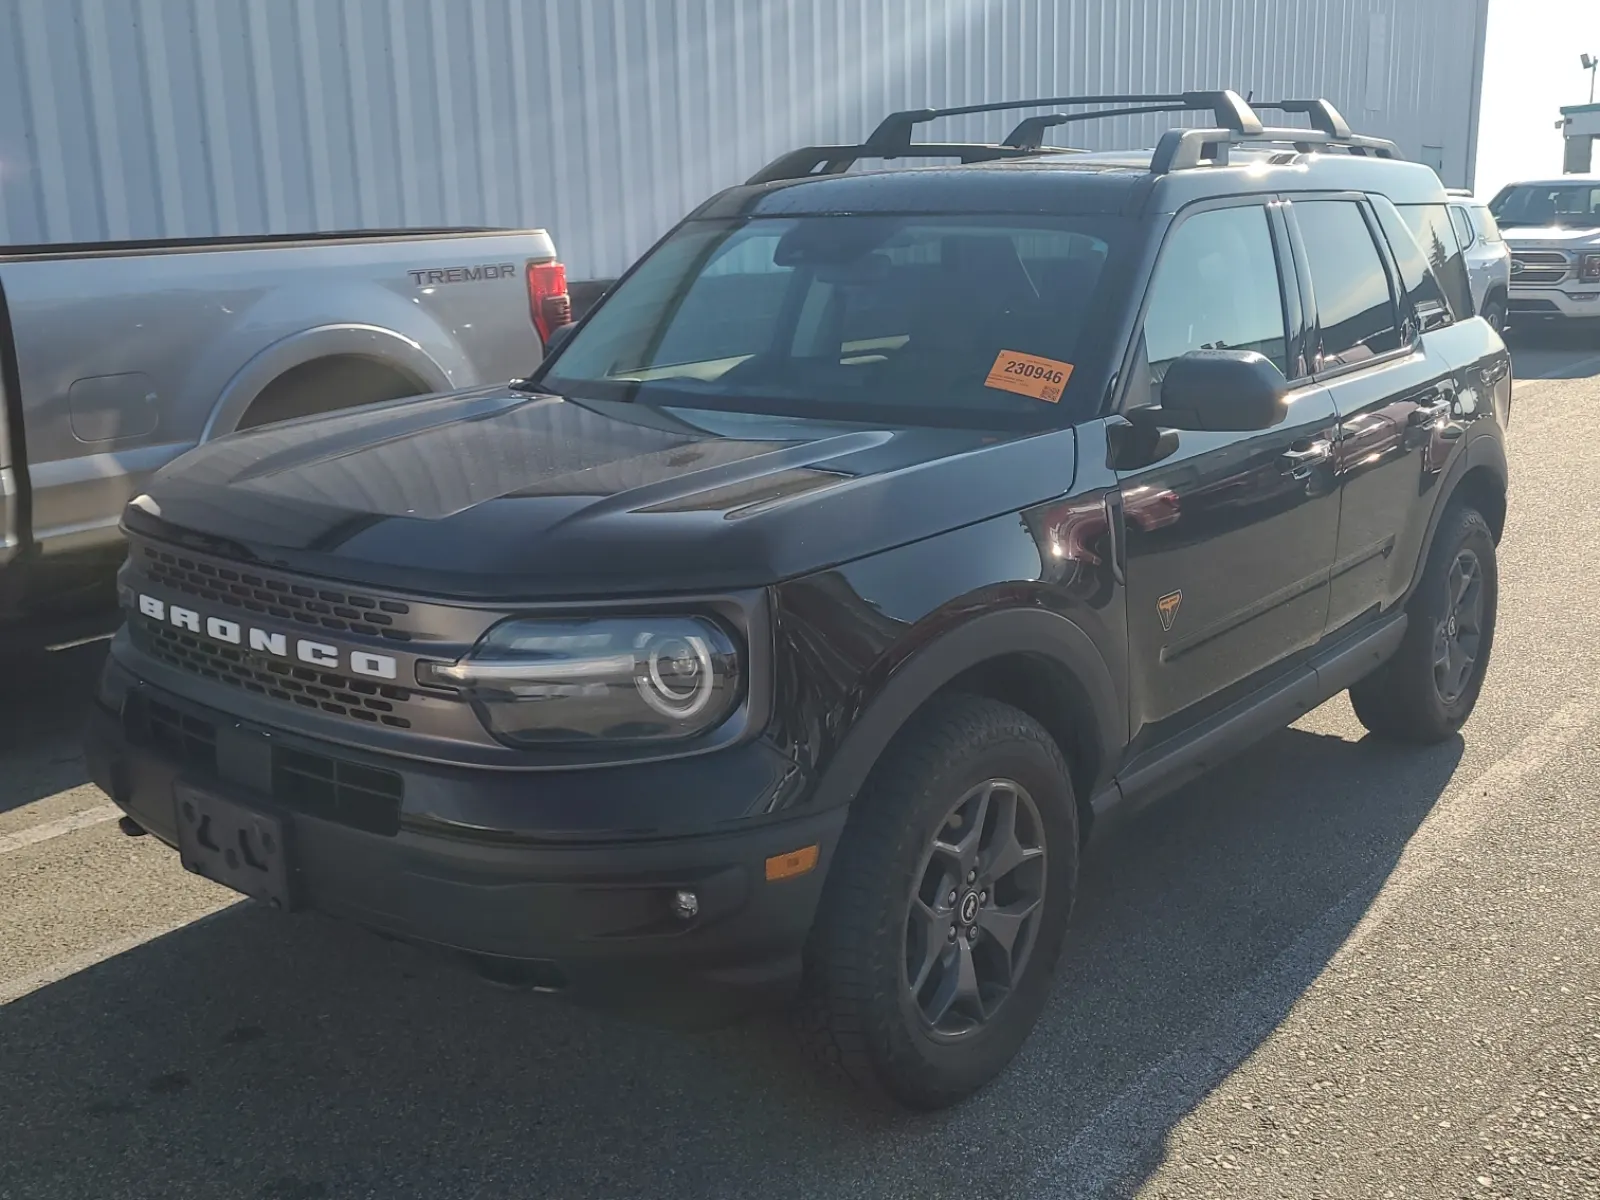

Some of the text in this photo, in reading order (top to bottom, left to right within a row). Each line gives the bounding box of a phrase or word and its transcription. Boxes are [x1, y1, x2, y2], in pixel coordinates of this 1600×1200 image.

[407, 262, 515, 284] TREMOR
[1004, 361, 1064, 384] 230946
[138, 594, 397, 679] BRONCO
